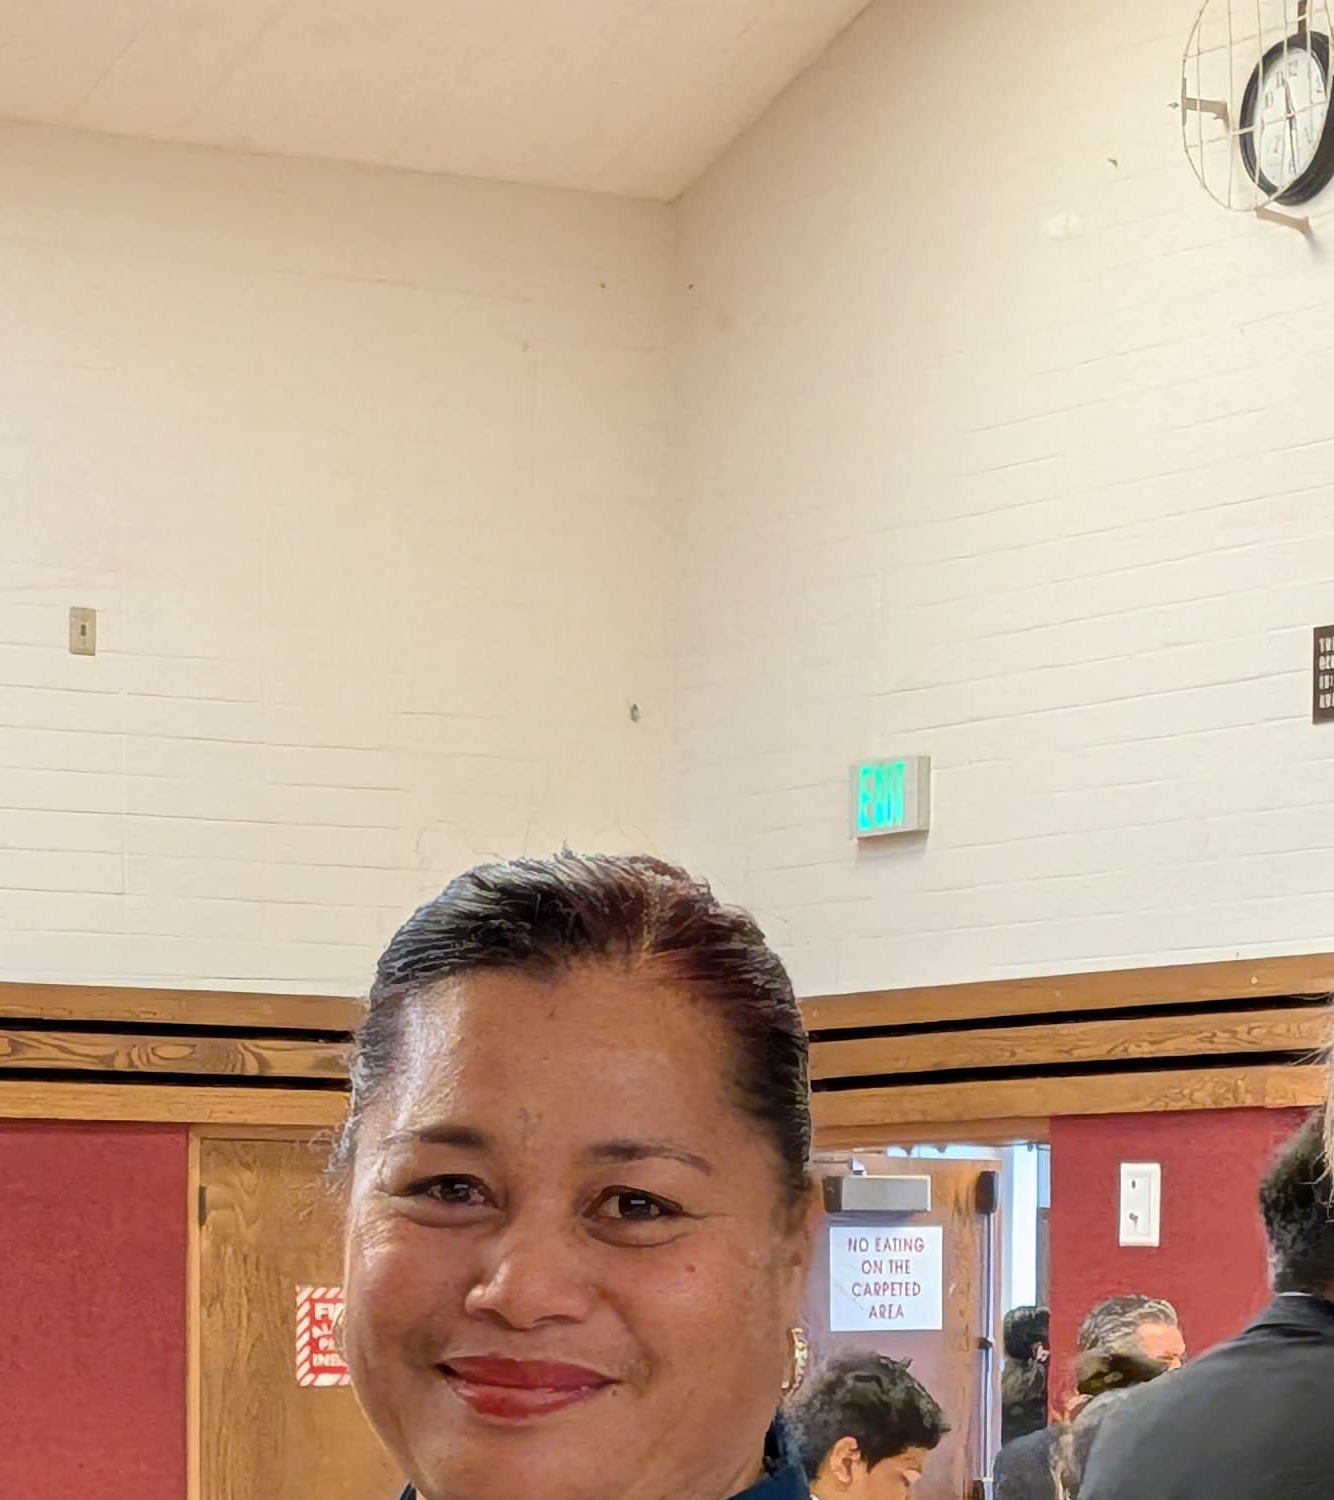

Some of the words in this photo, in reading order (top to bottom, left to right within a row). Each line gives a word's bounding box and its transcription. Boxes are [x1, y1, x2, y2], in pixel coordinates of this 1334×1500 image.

[847, 1237, 869, 1253] NO
[875, 1237, 925, 1253] EATING
[861, 1259, 883, 1275] ON
[888, 1259, 911, 1275] THE
[851, 1281, 921, 1297] CARPETED
[868, 1303, 904, 1320] AREA
